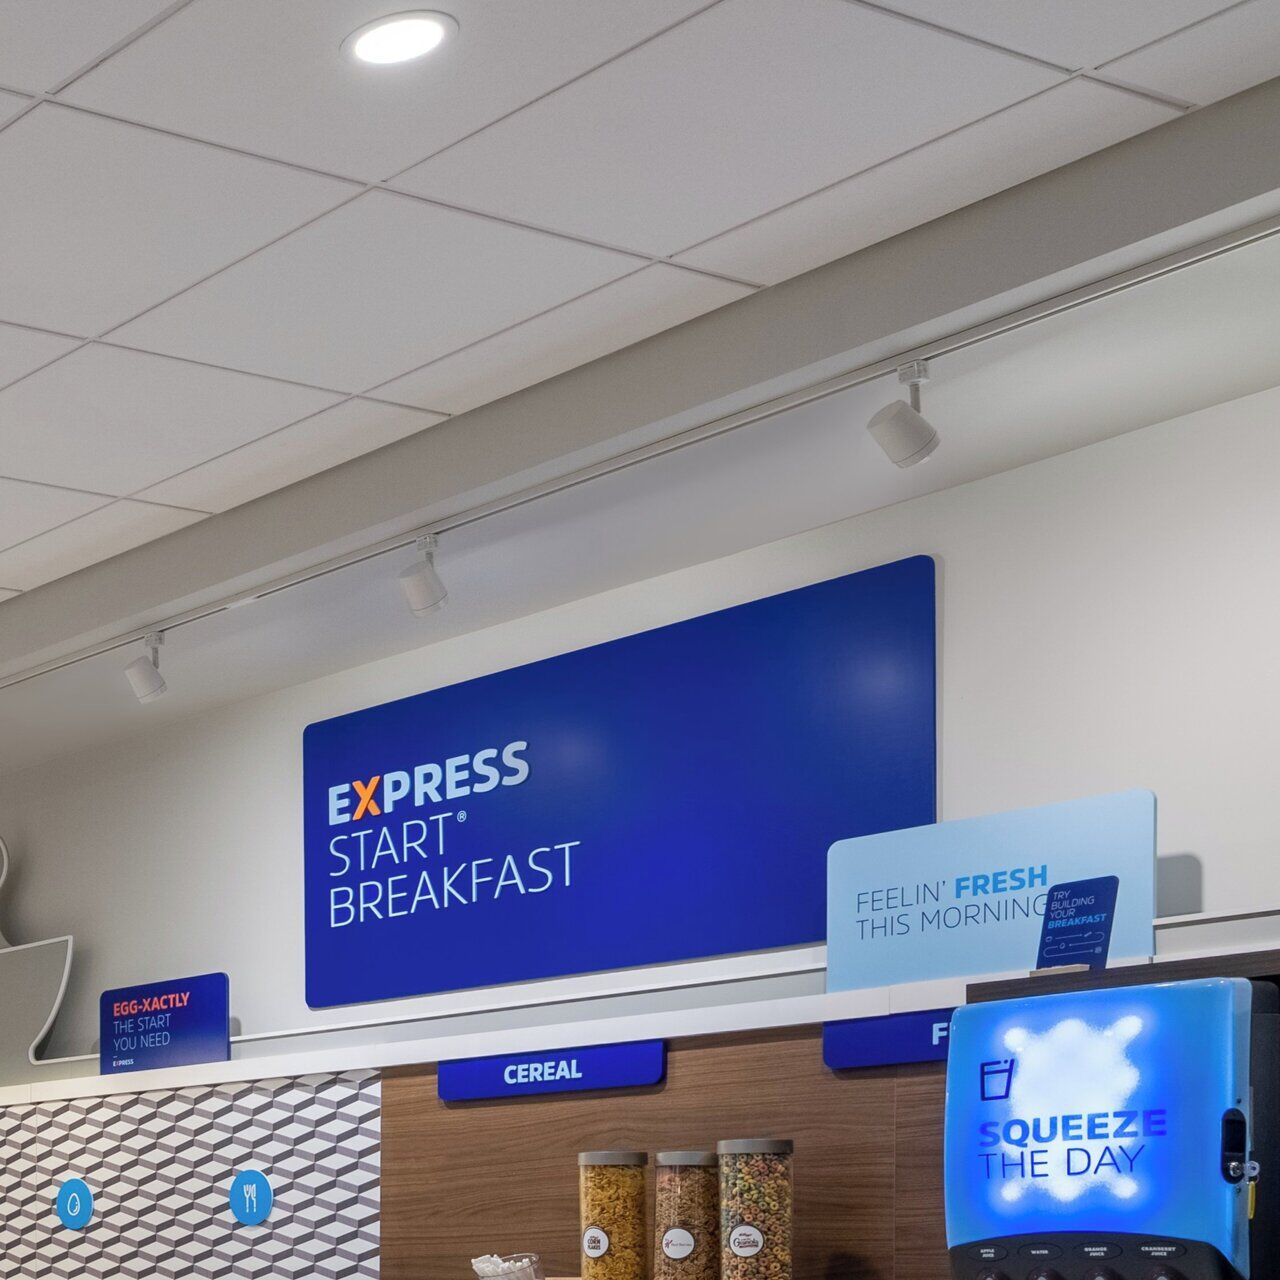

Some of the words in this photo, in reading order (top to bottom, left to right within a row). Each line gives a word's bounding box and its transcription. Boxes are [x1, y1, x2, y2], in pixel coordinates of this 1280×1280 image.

[328, 740, 530, 826] EXPRESS
[330, 840, 581, 928] BREAKFAST
[857, 880, 946, 914] FEELIN'
[955, 864, 1047, 899] FRESH
[1053, 890, 1071, 900] TRY
[1050, 908, 1076, 919] YOUR
[1051, 896, 1095, 910] BUILDING
[856, 912, 910, 940] THIS
[1048, 913, 1107, 929] BREAKFAST
[113, 991, 190, 1017] EGG-XACTLY
[113, 1018, 134, 1035] THE
[138, 1013, 171, 1032] START
[113, 1036, 137, 1051] YOU
[140, 1031, 170, 1048] NEED
[503, 1059, 582, 1084] CEREAL
[979, 1109, 1167, 1148] SQUEEZE
[978, 1149, 1049, 1179] THE
[1066, 1144, 1146, 1176] DAY
